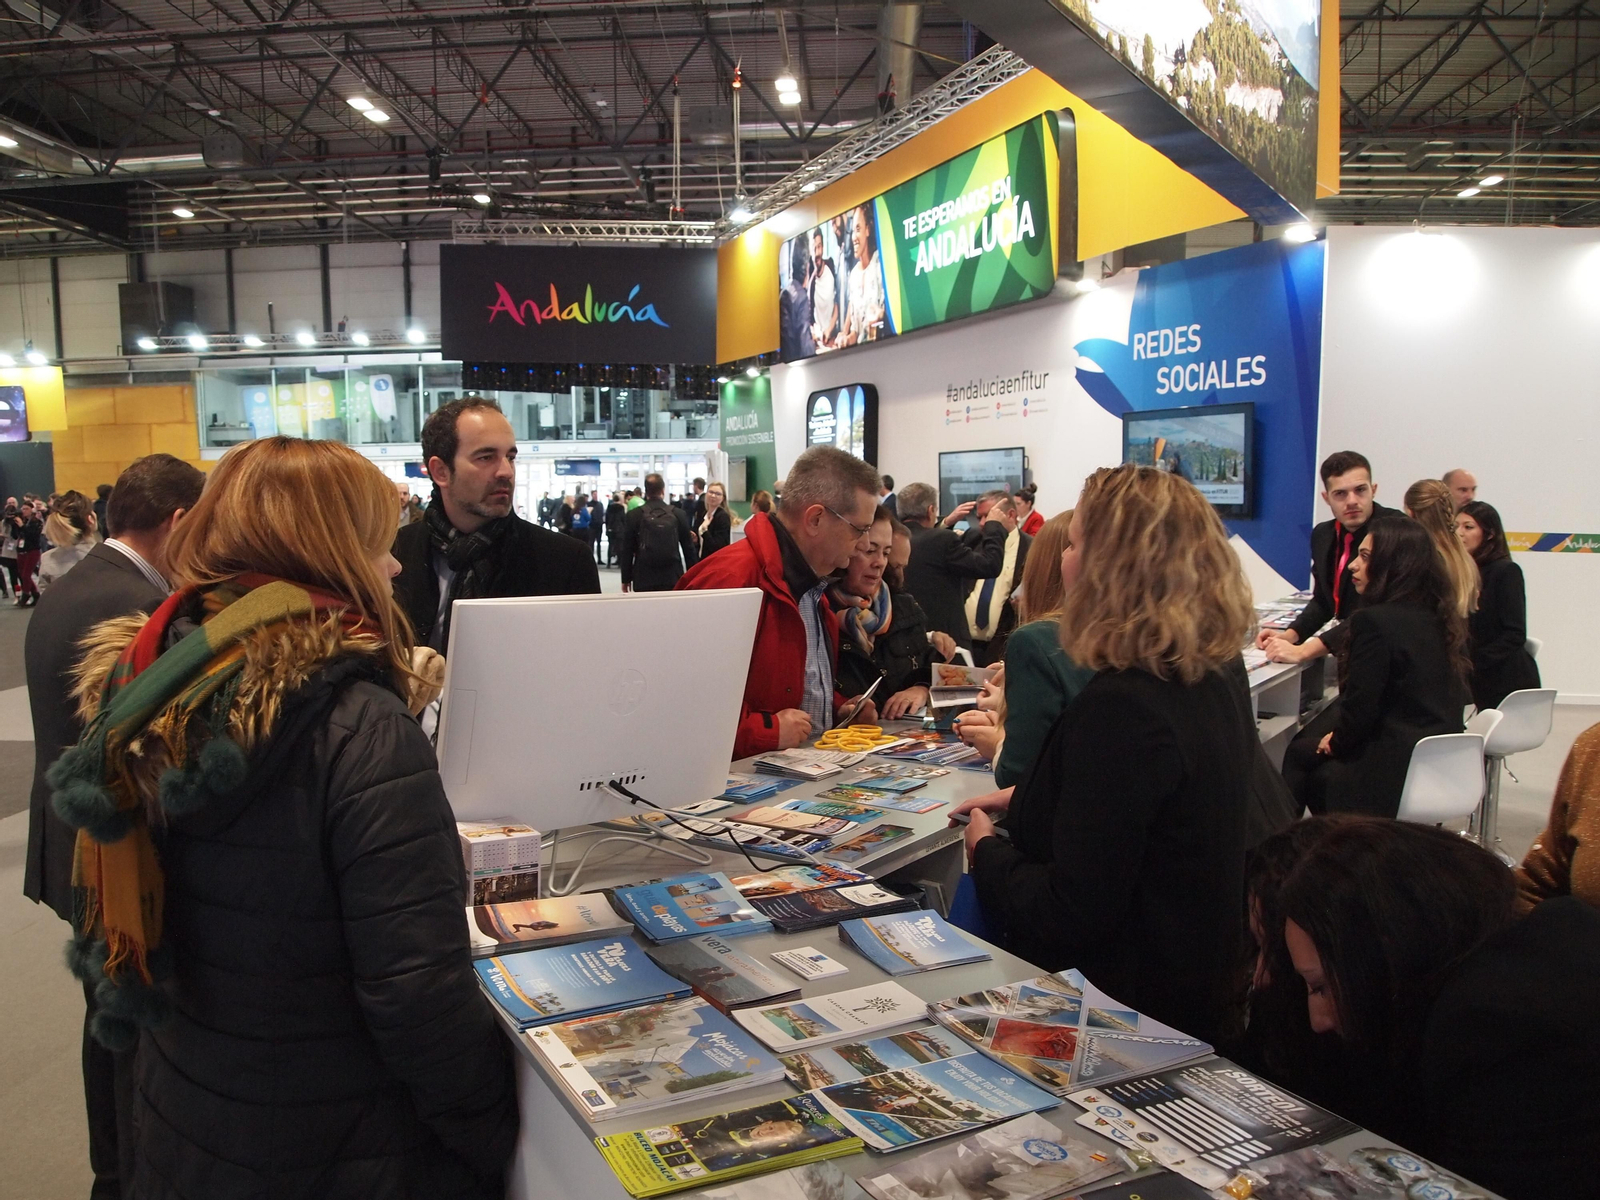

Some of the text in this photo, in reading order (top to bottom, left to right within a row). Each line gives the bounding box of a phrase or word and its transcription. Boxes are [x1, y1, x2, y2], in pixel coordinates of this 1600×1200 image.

[903, 176, 1012, 240] TE ESPERAMOS EN
[914, 195, 1036, 277] ANDALUCÍA
[487, 281, 670, 328] Andalucía
[1133, 324, 1201, 360] REDES
[946, 370, 1049, 403] #andaluciaenfitur
[1156, 355, 1267, 394] SOCIALES
[725, 410, 758, 432] ANDALUCÍA
[701, 936, 732, 954] vera
[1212, 1068, 1307, 1113] ¡SORTEO!
[633, 1132, 653, 1153] BUCEO
[649, 1153, 677, 1182] MOJACAR
